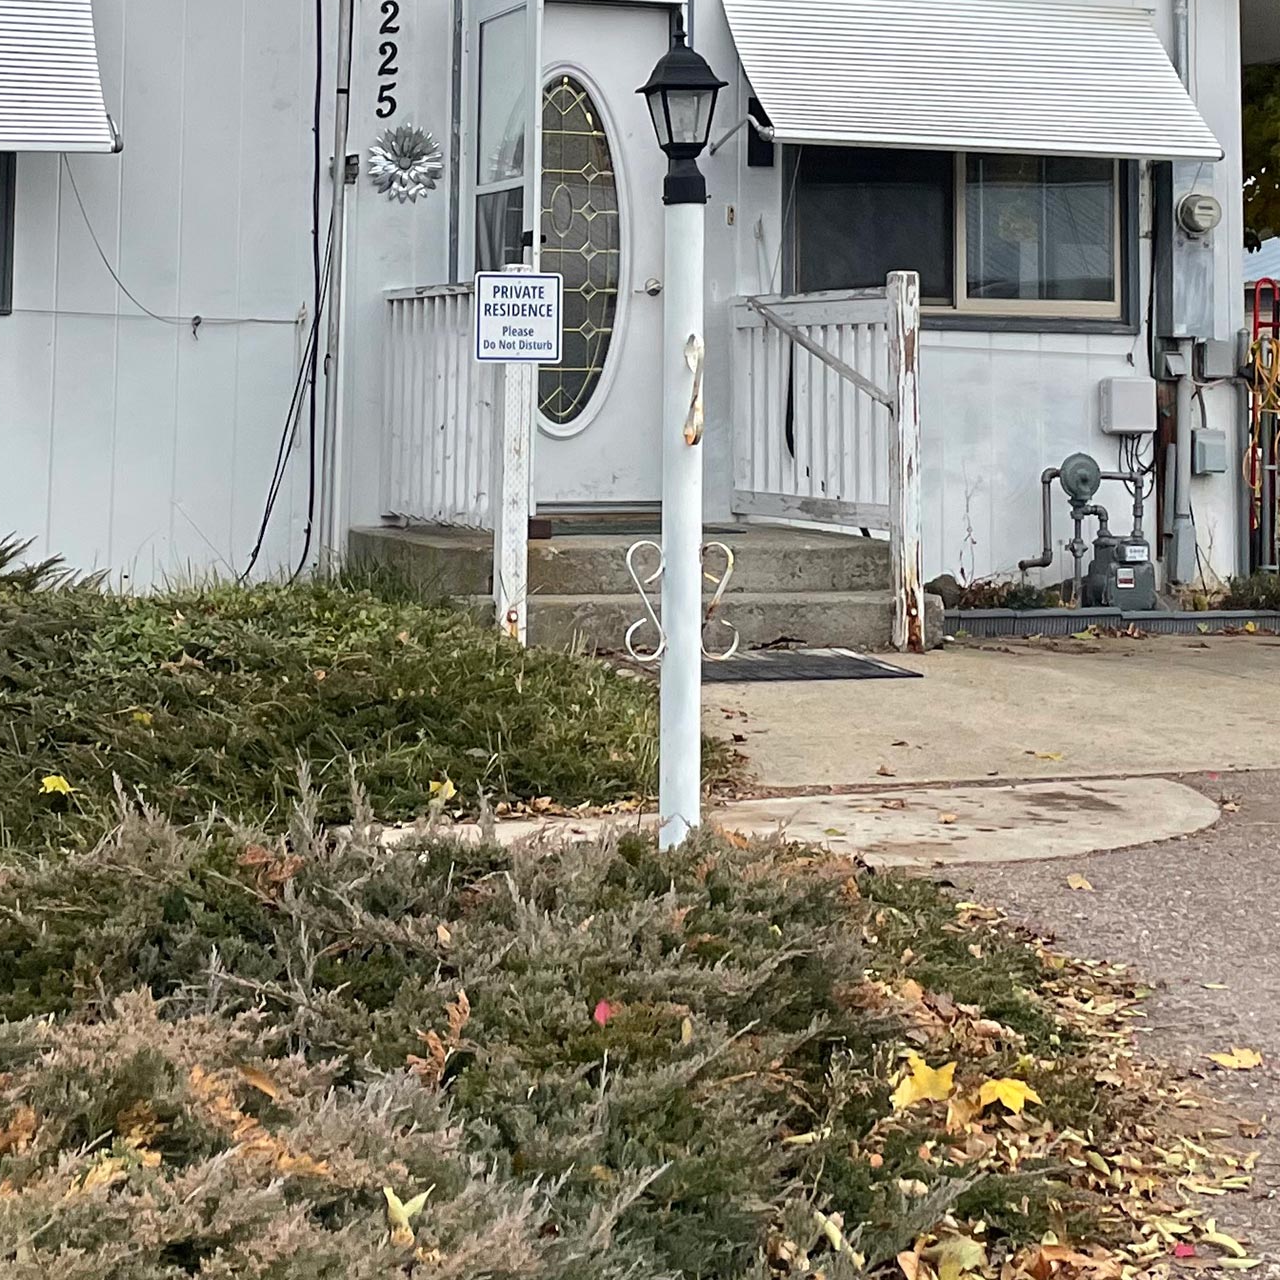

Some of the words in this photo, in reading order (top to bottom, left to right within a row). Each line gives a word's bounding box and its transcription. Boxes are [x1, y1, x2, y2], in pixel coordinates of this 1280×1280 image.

[493, 285, 545, 299] PRIVATE
[484, 303, 553, 317] RESIDENCE
[502, 325, 534, 336] Please
[483, 340, 496, 350] Do
[499, 340, 516, 350] Not
[519, 340, 553, 350] Disturb
